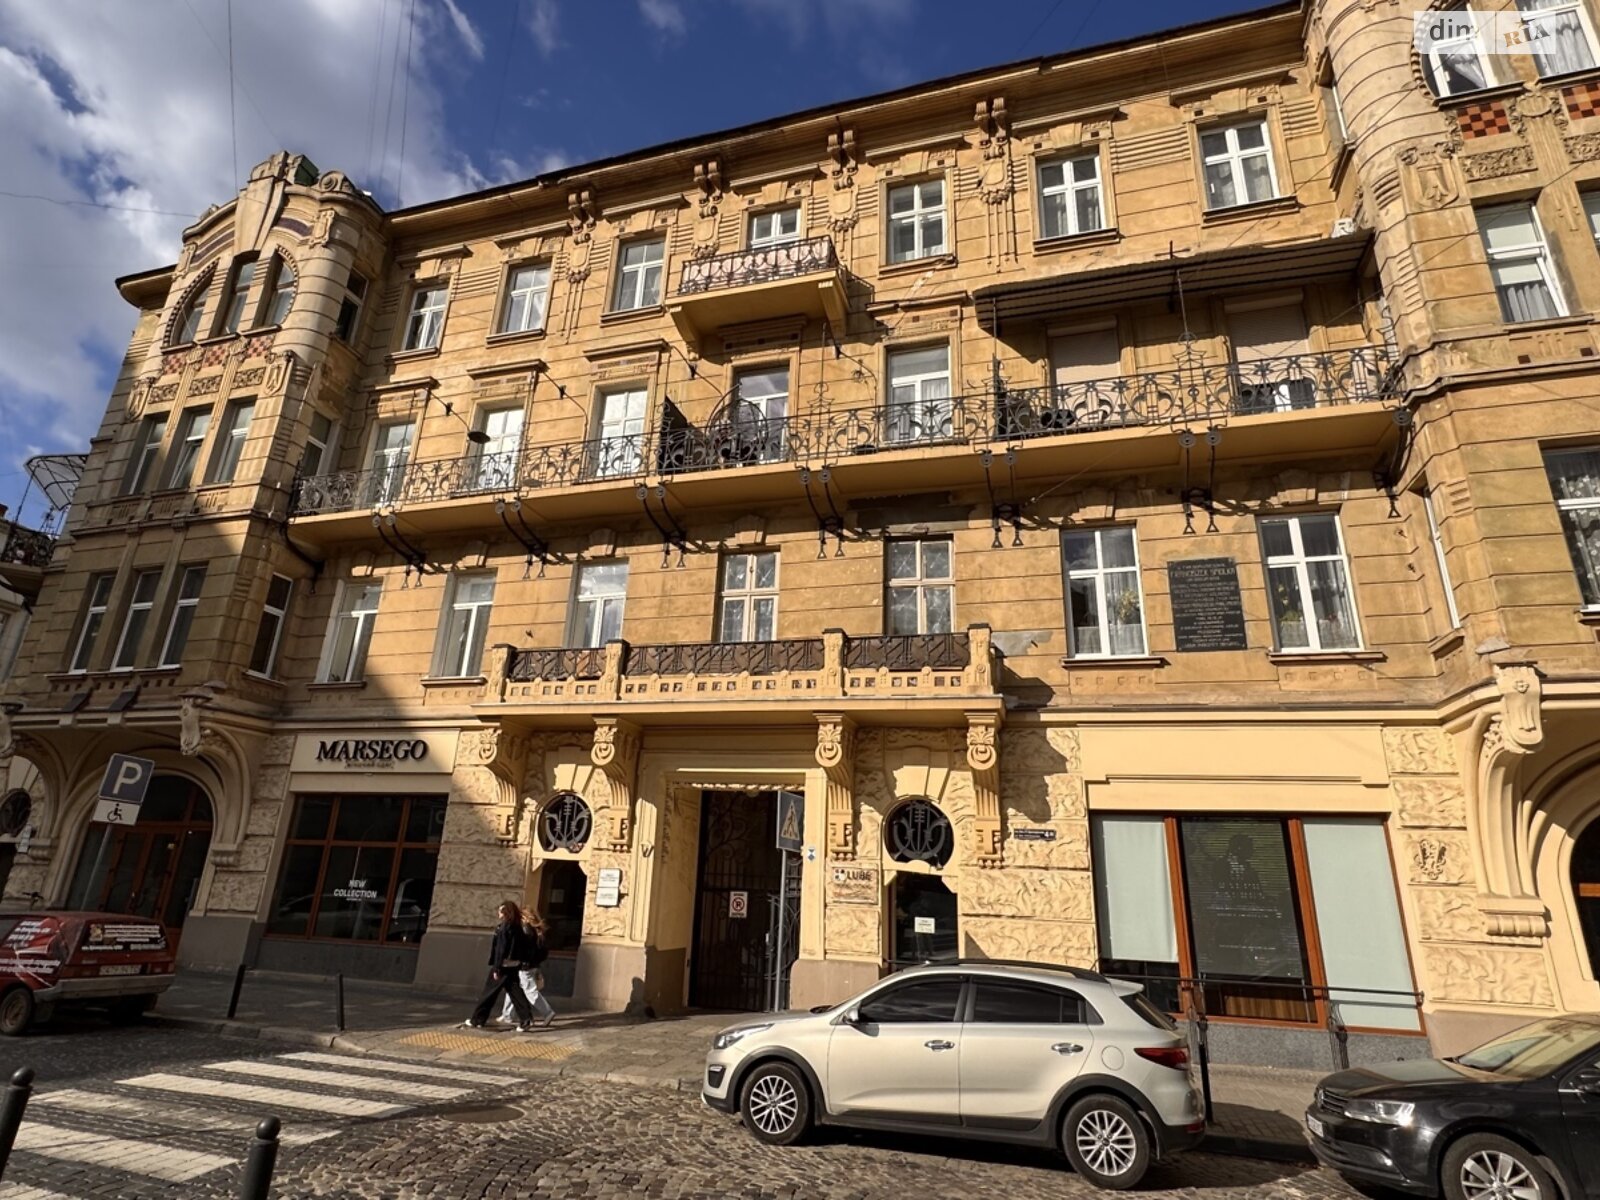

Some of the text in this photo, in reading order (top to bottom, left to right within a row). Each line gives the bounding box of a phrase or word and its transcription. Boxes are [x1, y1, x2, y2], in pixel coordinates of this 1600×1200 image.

[316, 739, 429, 761] MARSEGO
[112, 760, 142, 795] P
[348, 879, 367, 888] NEW
[333, 888, 378, 899] COLLECTION
